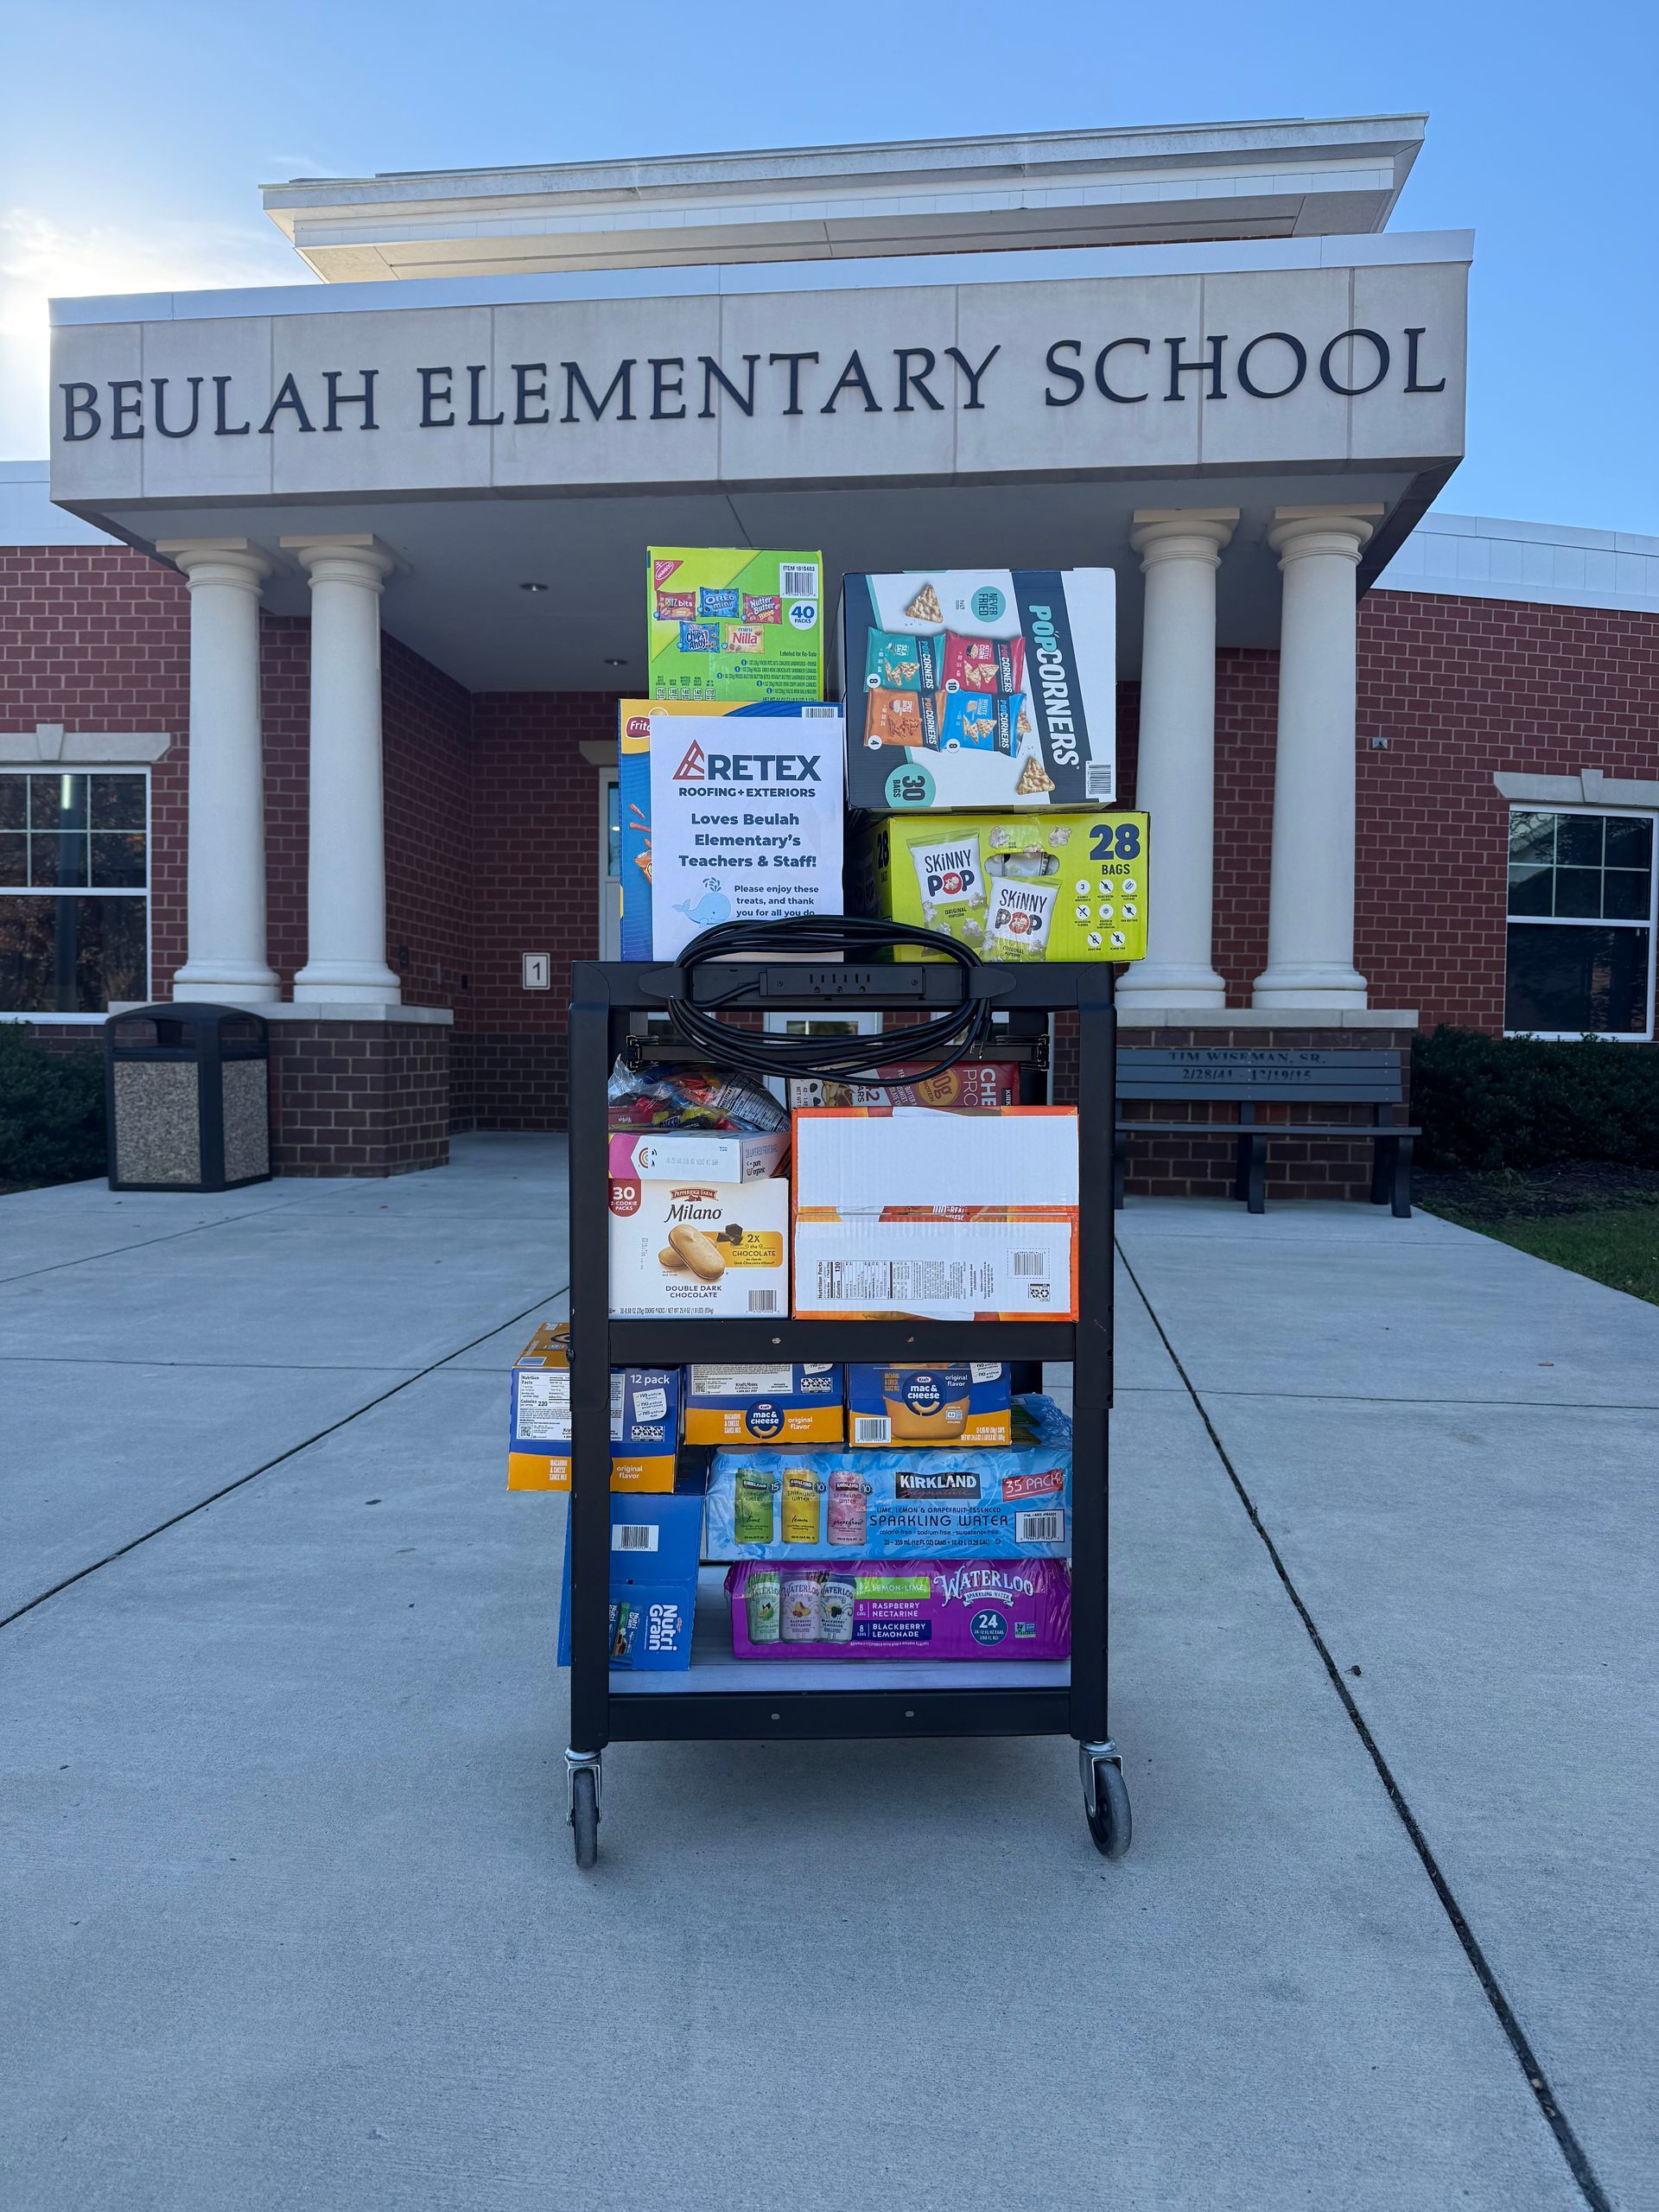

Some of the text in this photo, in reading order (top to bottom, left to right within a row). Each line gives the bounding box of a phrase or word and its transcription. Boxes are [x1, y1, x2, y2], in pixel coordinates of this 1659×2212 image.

[59, 327, 1446, 442] BEULAH ELEMENTARY SCHOOL
[664, 598, 677, 607] RITZ
[705, 594, 735, 605] OREO
[749, 596, 772, 607] Nutter
[979, 594, 988, 616] FRIED
[989, 593, 998, 615] NEVER
[753, 603, 775, 614] Butter
[791, 606, 815, 619] 40
[686, 631, 704, 642] Chips
[732, 632, 758, 645] Nilla
[921, 640, 934, 690] POPCORNERS
[948, 682, 957, 690] 10
[1029, 605, 1079, 766] POPCORNERS
[925, 697, 937, 745] POPCORNERS
[999, 699, 1009, 749] POPCORNERS
[708, 754, 822, 781] RETEX
[679, 787, 736, 797] ROOFING
[746, 788, 816, 798] EXTERIORS
[902, 775, 925, 801] 30
[691, 813, 799, 825] Loves Beulah
[695, 834, 801, 849] Elementary's
[1090, 823, 1141, 860] 28
[877, 830, 889, 869] 28
[678, 855, 817, 868] Teachers & Staff!
[925, 849, 971, 873] SKiNNY
[1102, 864, 1130, 875] BAGS
[766, 885, 791, 894] enjoy
[927, 870, 975, 897] POP
[1000, 889, 1047, 913] SKiNNY
[995, 909, 1042, 935] POP
[532, 962, 540, 981] 1
[1169, 1052, 1199, 1061] TIM
[923, 1080, 935, 1103] ROTEIN
[613, 1186, 636, 1200] 30
[664, 1205, 722, 1223] Milano
[747, 1234, 760, 1243] 2X
[630, 1374, 670, 1386] 12 pack
[743, 1479, 767, 1490] KIRKLAND
[789, 1479, 813, 1489] KIRKLAND
[816, 1483, 825, 1491] 10
[899, 1474, 977, 1489] KIRKLAND
[1006, 1472, 1060, 1494] 35 PACK
[832, 1517, 863, 1528] grapefruit
[869, 1515, 1008, 1527] SPARKLING WATER
[782, 1582, 819, 1600] WATERLOO
[933, 1565, 1034, 1607] WATERLOO
[649, 1604, 664, 1650] Grain
[660, 1605, 678, 1651] Nutri
[979, 1614, 998, 1629] 24
